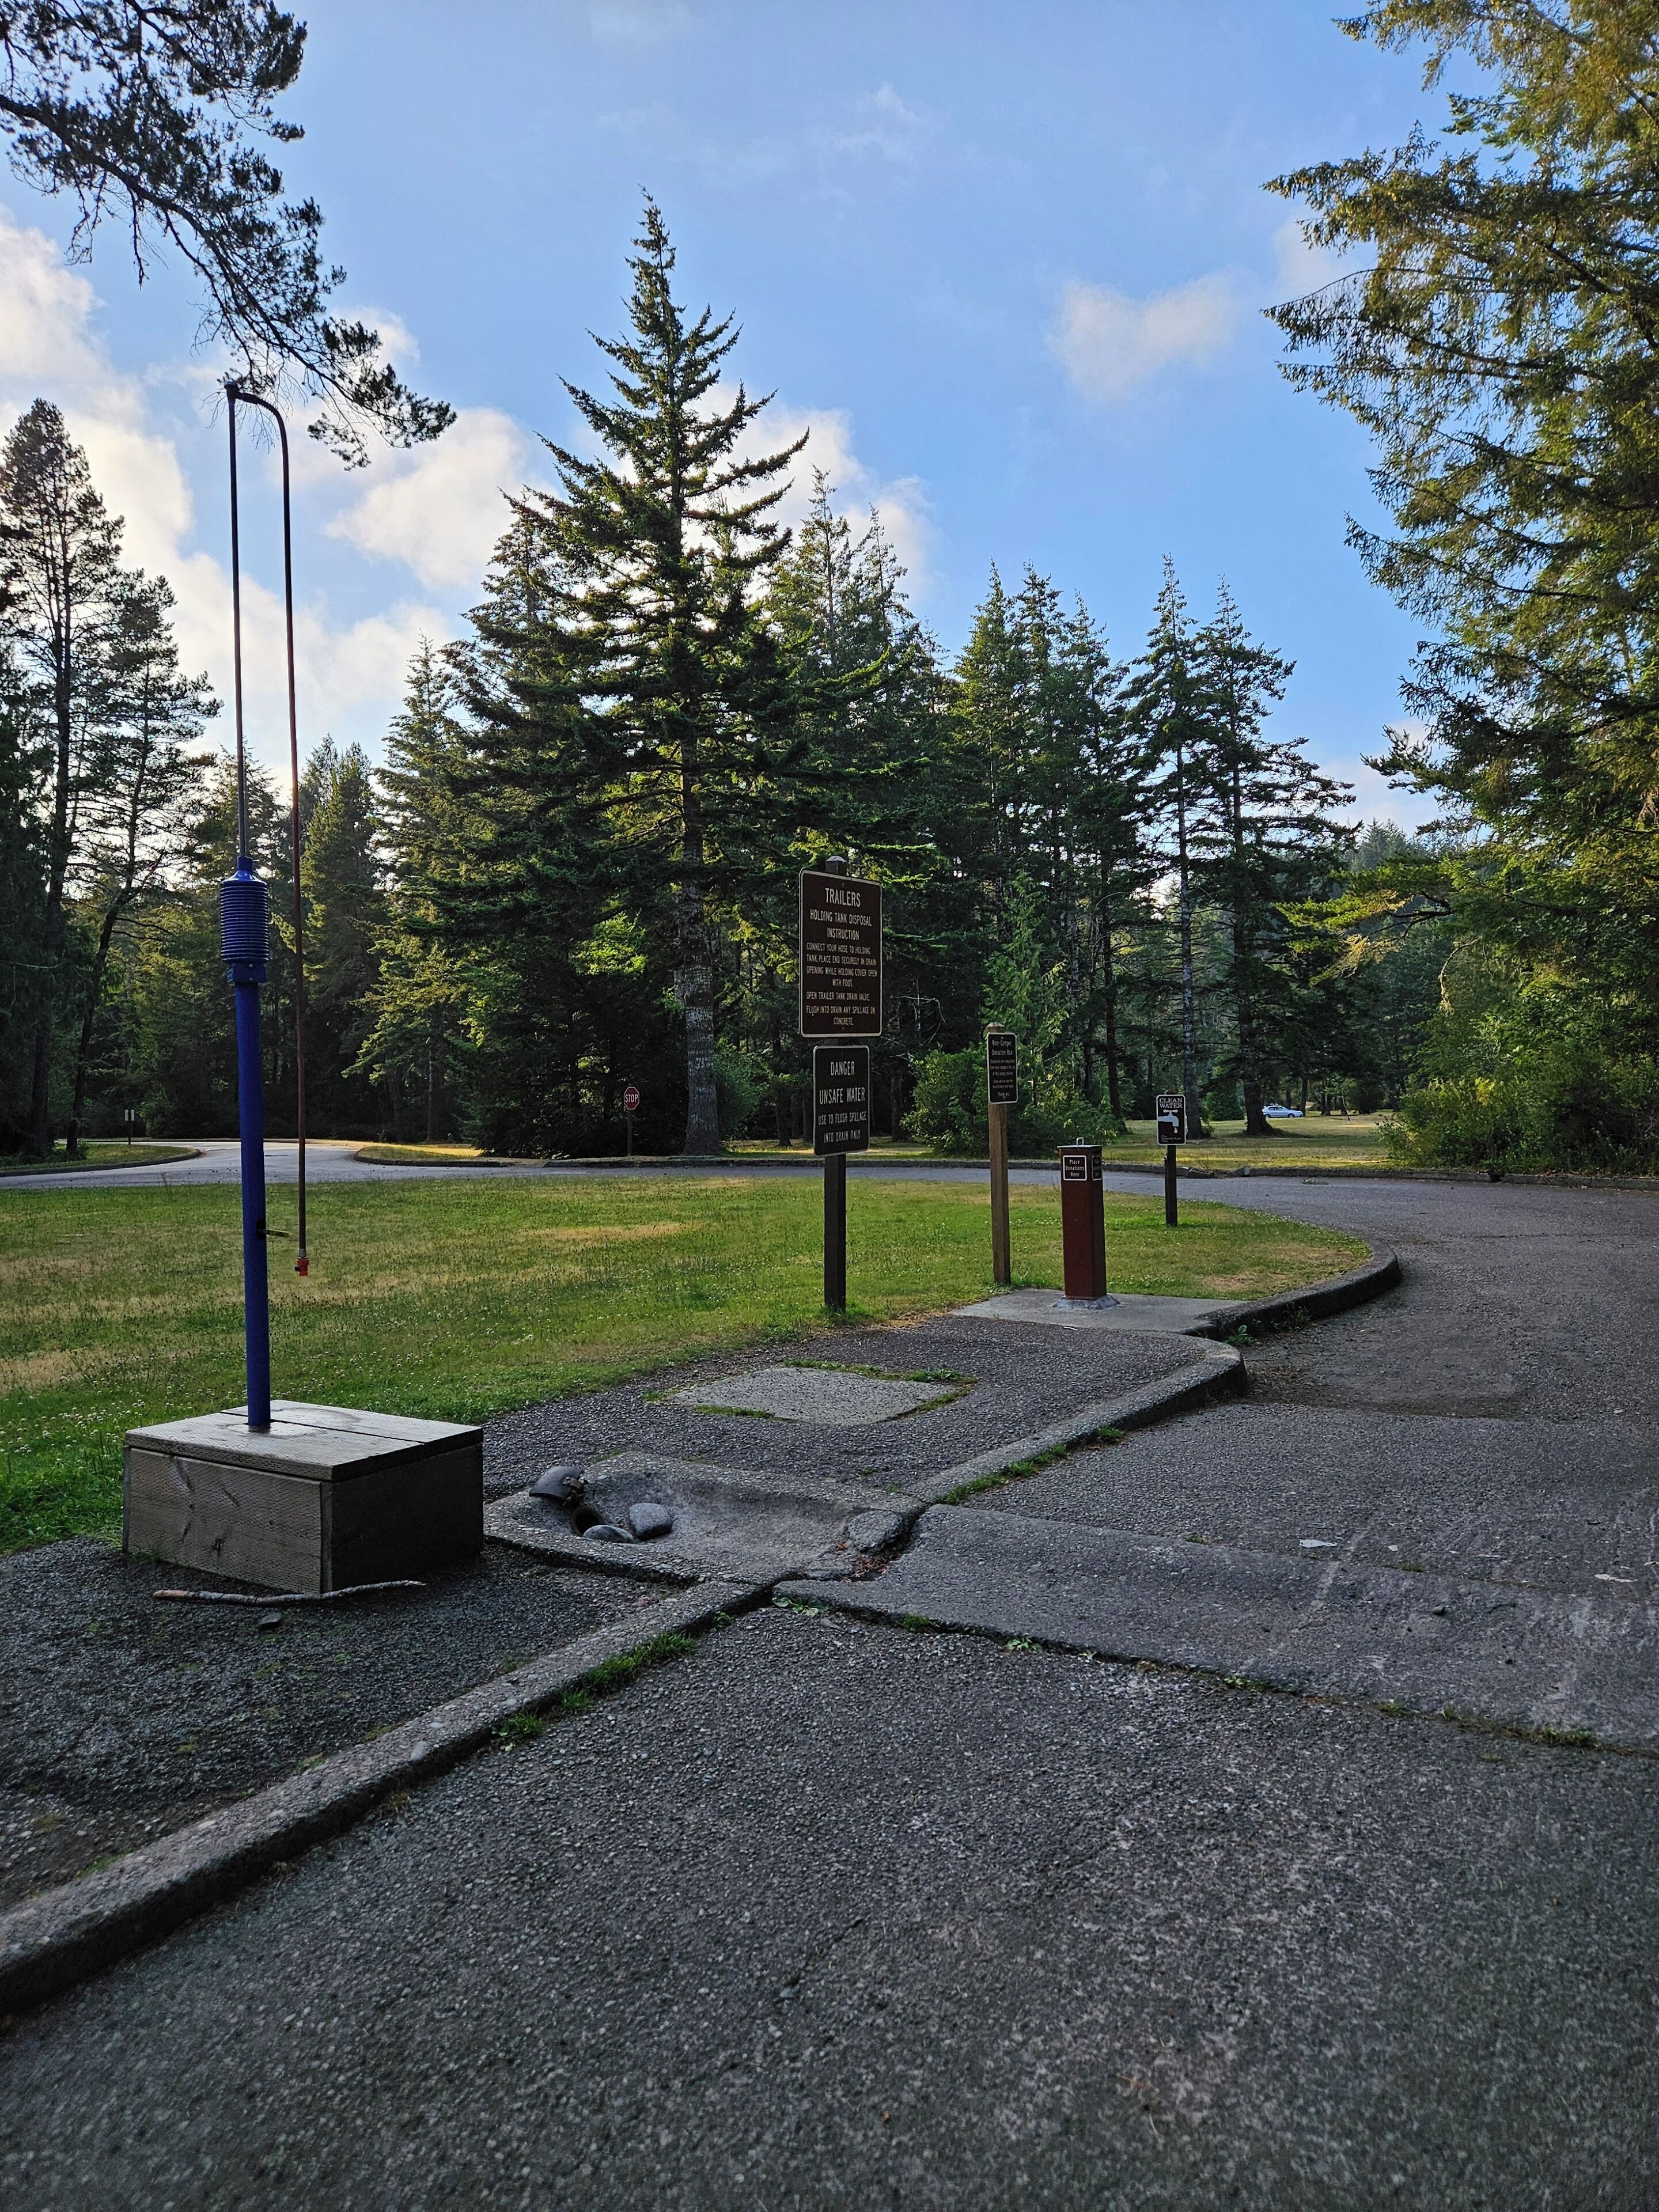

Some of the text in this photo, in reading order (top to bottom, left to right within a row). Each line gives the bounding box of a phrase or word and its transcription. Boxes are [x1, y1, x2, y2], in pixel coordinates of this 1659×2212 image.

[825, 888, 861, 907] TRAILERS
[810, 908, 872, 926] HOLDING TANK DISPOSAL
[827, 927, 859, 940] INSTRUCTION
[806, 942, 870, 955] CONNECT YOUR HOSE TO HOLDING
[842, 956, 859, 965] SECURELY
[806, 966, 823, 974] OPENING
[825, 967, 836, 975] WHILE
[838, 968, 854, 976] HOLDING
[855, 968, 866, 976] COVER
[832, 979, 842, 987] WITH
[806, 991, 817, 999] OPEN
[818, 992, 834, 1000] TRAILER
[836, 992, 846, 1000] TANK
[846, 993, 858, 1001] DRAIN
[806, 1005, 819, 1014] FLUSH
[843, 1006, 851, 1014] ANY
[852, 1006, 869, 1014] SPILLAGE
[870, 1006, 875, 1014] ON
[831, 1061, 855, 1076] DANGER
[625, 1094, 638, 1103] STOP
[819, 1087, 865, 1104] UNSAFE WATER
[818, 1111, 867, 1126] USE TO FLUSH SPILLAGE
[824, 1130, 861, 1143] INTO DRAIN ONLY
